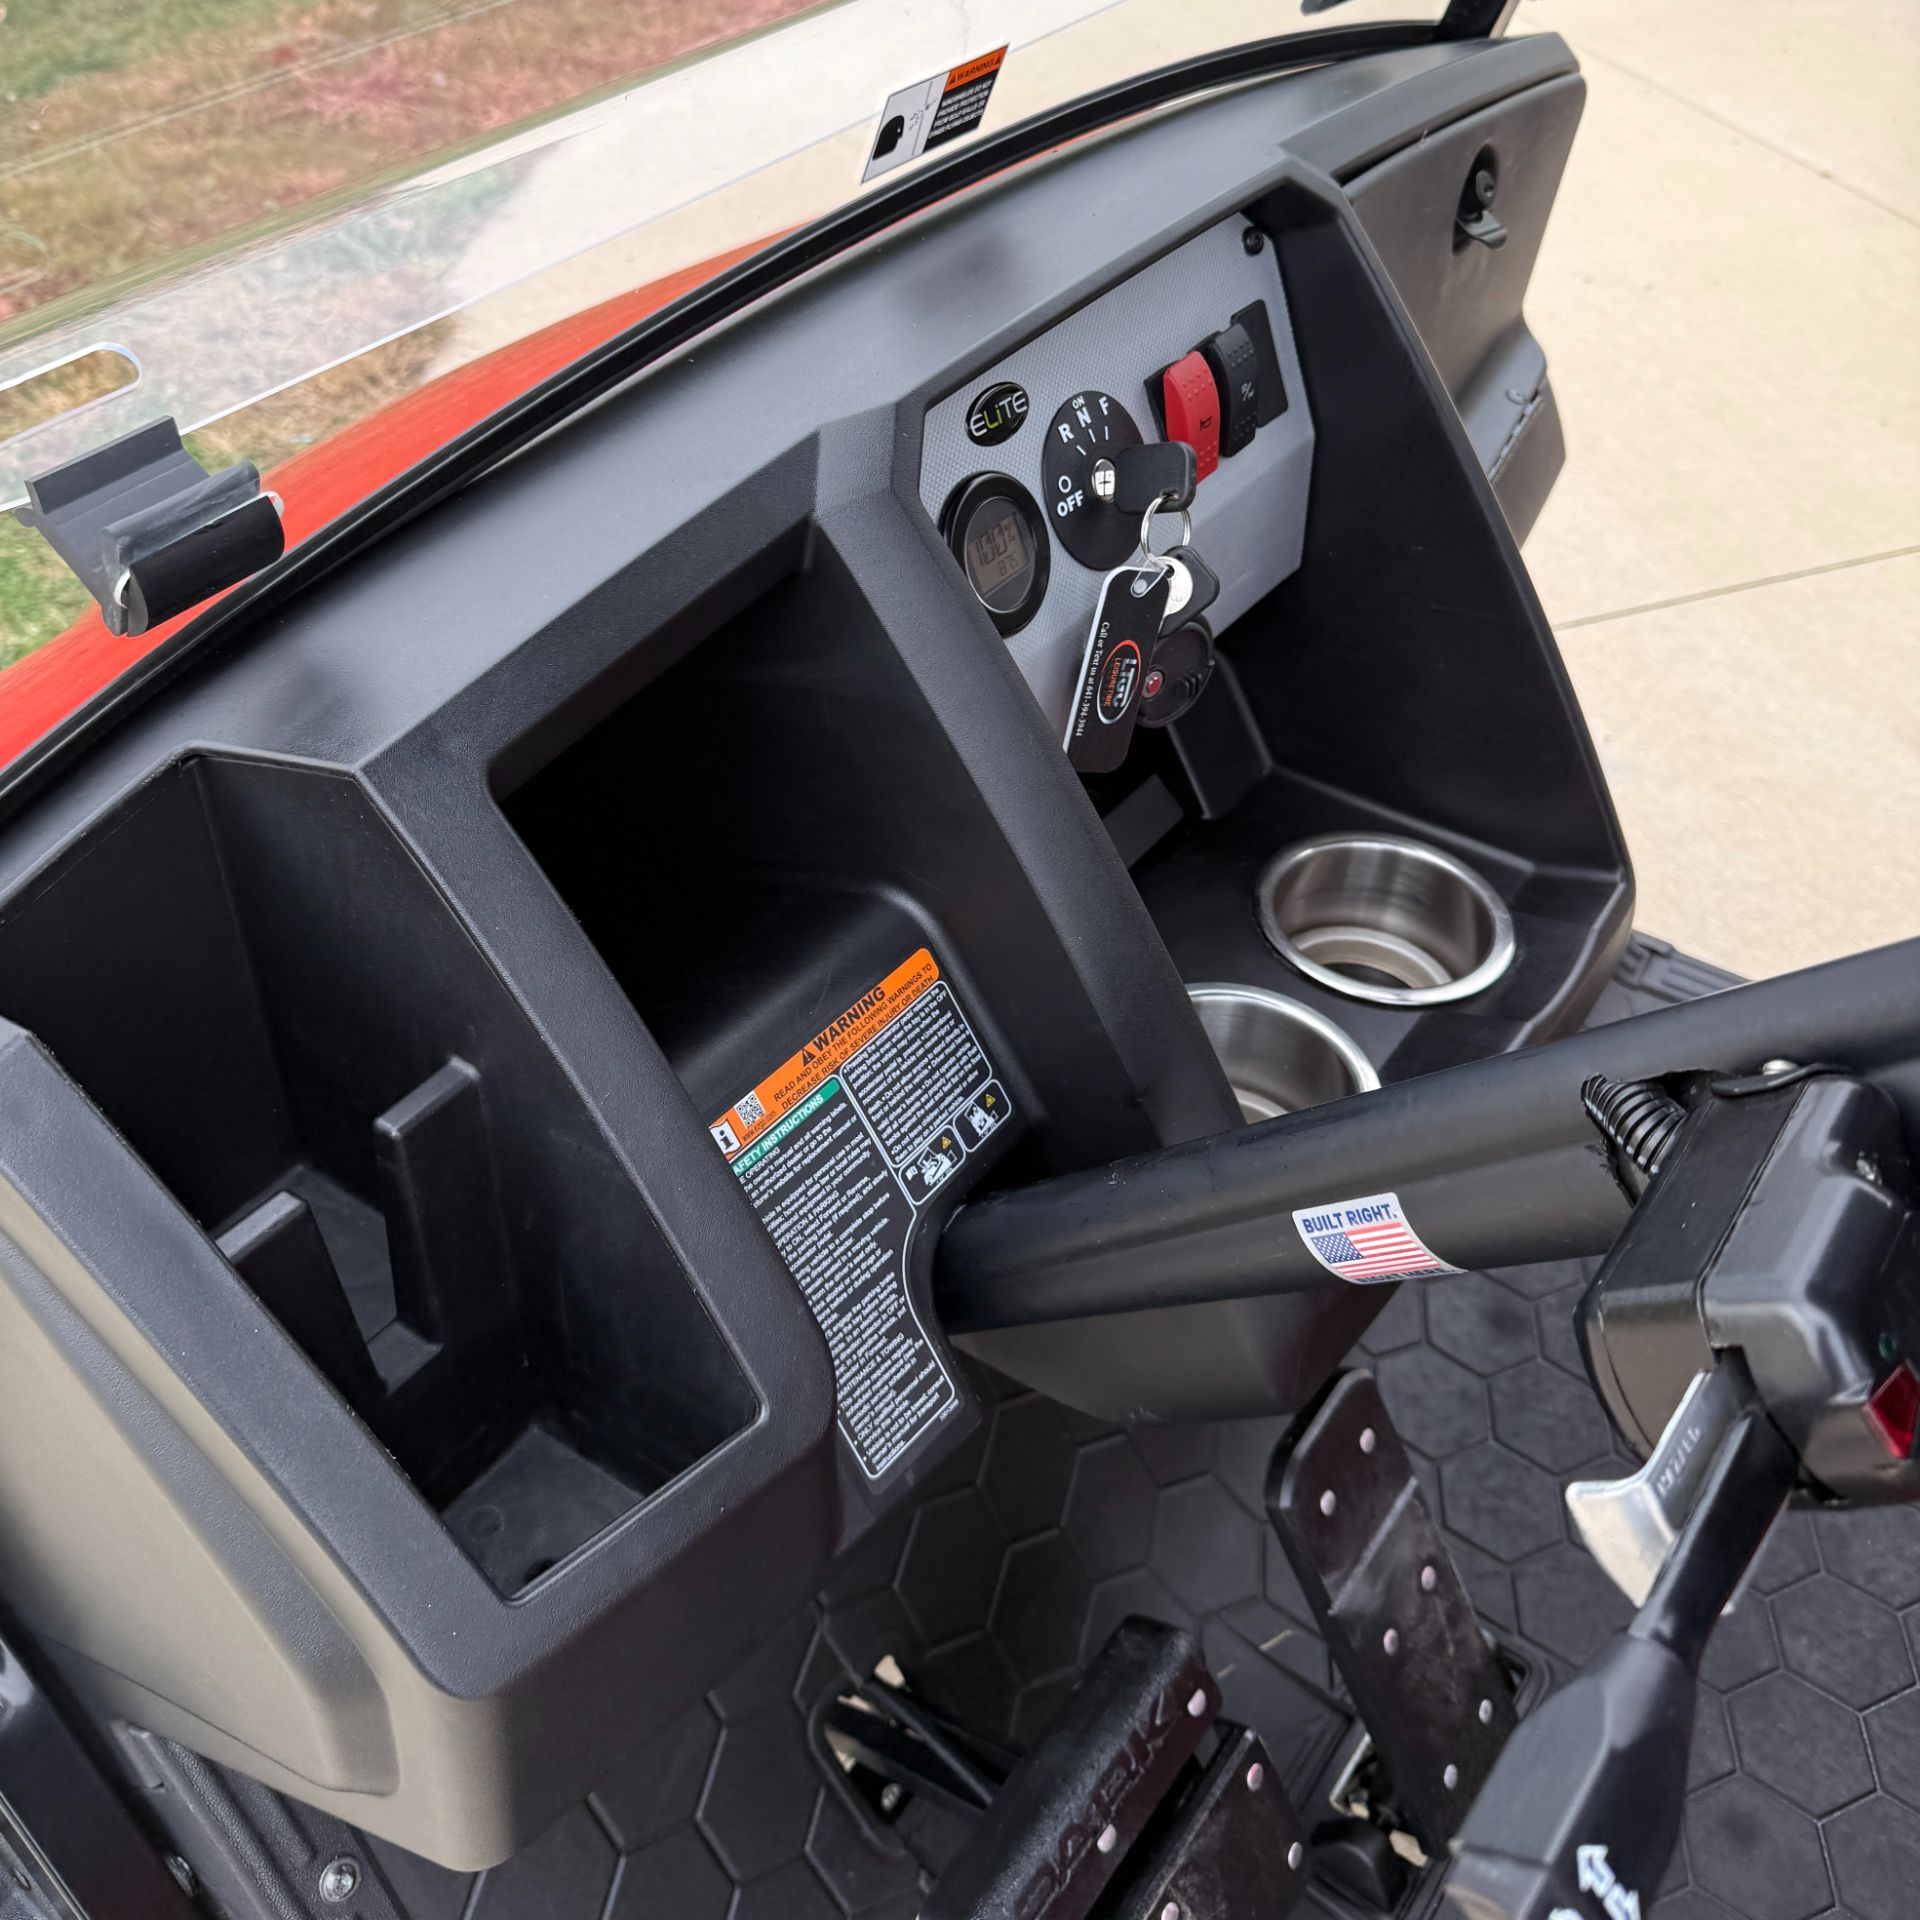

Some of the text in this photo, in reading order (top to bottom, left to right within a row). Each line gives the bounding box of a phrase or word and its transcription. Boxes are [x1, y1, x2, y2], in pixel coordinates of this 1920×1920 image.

[1072, 396, 1085, 409] ON
[1058, 396, 1109, 443] R N F
[1057, 489, 1084, 517] OFF
[1098, 640, 1105, 649] or
[1100, 622, 1110, 638] Call
[1091, 667, 1097, 676] us
[1093, 649, 1103, 666] Text
[1088, 676, 1095, 684] at
[773, 961, 932, 1102] READ AND OBEY THE FOLLOWING WARNINGS TO
[811, 983, 887, 1054] WARNING
[781, 1071, 822, 1110] DECREASE
[820, 1056, 839, 1076] RISK
[838, 1046, 850, 1060] OF
[848, 1022, 878, 1051] SEVERE
[876, 1001, 901, 1027] INJURY
[899, 992, 912, 1006] OR
[732, 1092, 824, 1175] AFETY INSTRUCTIONS
[744, 1145, 781, 1180] OPERATING
[806, 1211, 814, 1221] &
[811, 1189, 839, 1216] PARKING
[1302, 1204, 1398, 1233] BUILT RIGHT.
